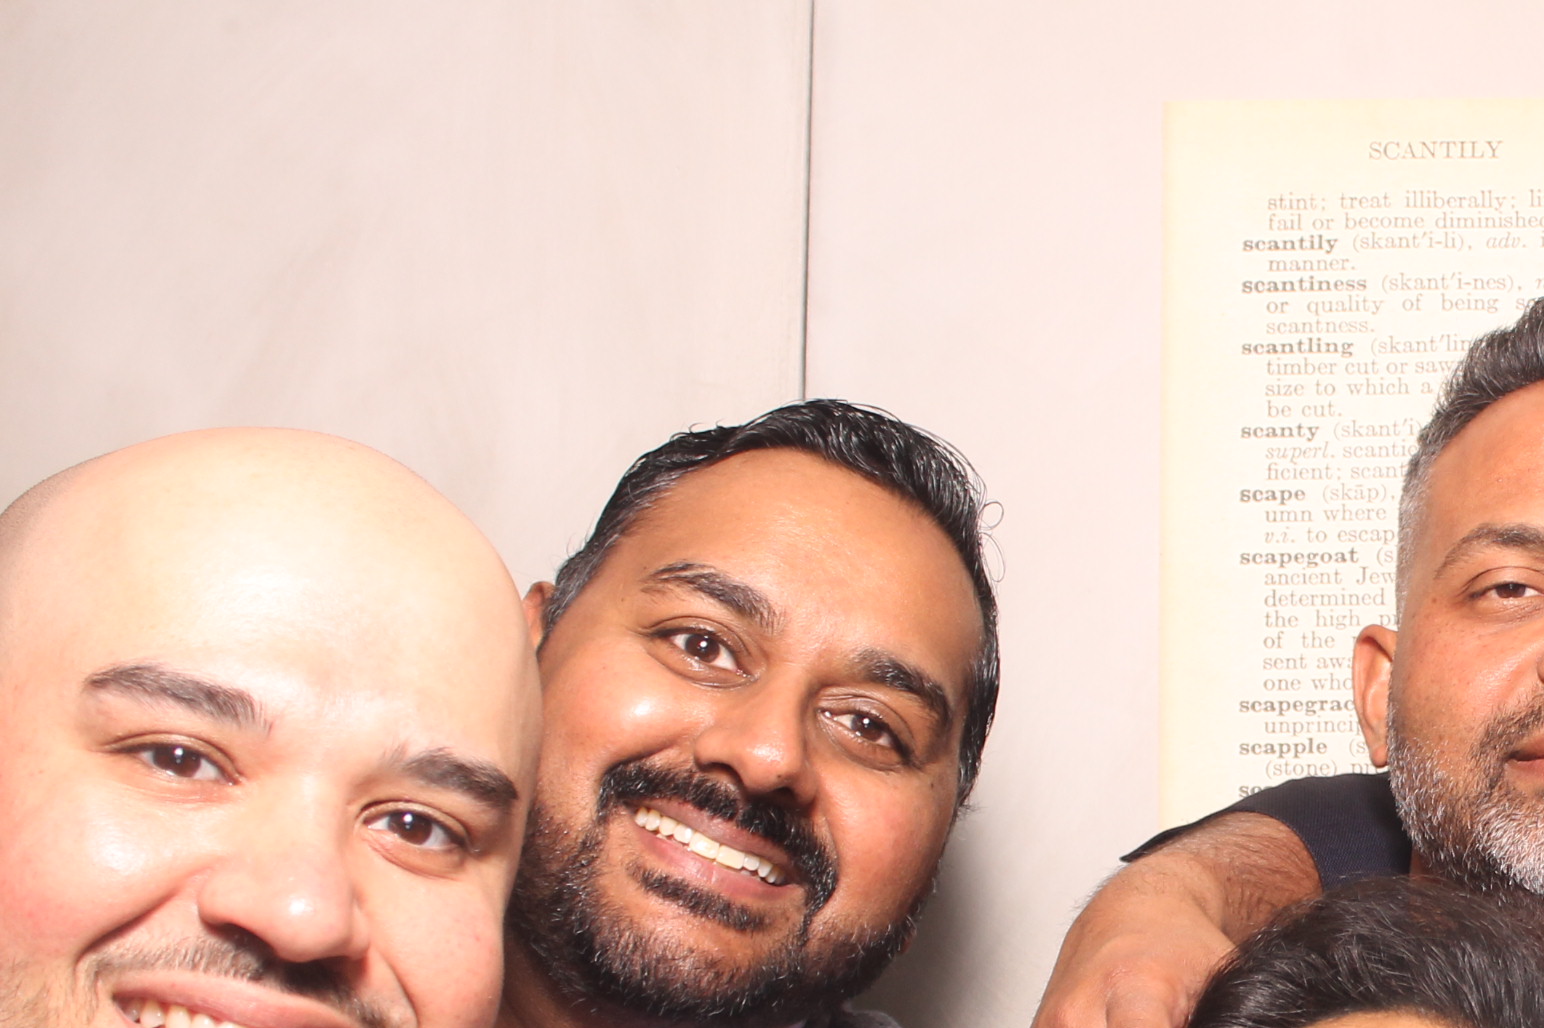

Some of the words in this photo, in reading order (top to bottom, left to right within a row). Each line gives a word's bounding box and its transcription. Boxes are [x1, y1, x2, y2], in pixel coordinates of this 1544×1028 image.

[1368, 140, 1503, 161] SCANTILY
[1267, 192, 1327, 211] stint;
[1340, 191, 1391, 209] treat
[1405, 189, 1516, 211] illiberally;
[1268, 213, 1302, 231] fail
[1312, 217, 1334, 231] or
[1345, 211, 1425, 230] become
[1242, 234, 1338, 253] scantily
[1486, 231, 1527, 249] adv.
[1267, 257, 1357, 273] manner.
[1241, 275, 1368, 294] scantiness
[1266, 300, 1289, 315] or
[1307, 294, 1384, 316] quality
[1402, 294, 1424, 312] of
[1441, 293, 1499, 313] being
[1266, 317, 1375, 335] scantness.
[1241, 337, 1354, 357] scantling
[1266, 357, 1337, 376] timber
[1344, 359, 1379, 375] cut
[1386, 363, 1409, 375] or
[1265, 378, 1304, 397] size
[1315, 380, 1336, 397] to
[1347, 376, 1410, 396] which
[1420, 381, 1433, 394] a
[1267, 400, 1292, 418] be
[1301, 401, 1343, 418] cut.
[1241, 424, 1320, 442] scanty
[1265, 441, 1335, 465] superl.
[1266, 462, 1342, 481] ficient;
[1239, 487, 1306, 506] scape
[1264, 508, 1313, 523] umn
[1323, 504, 1387, 522] where
[1264, 526, 1296, 544] v.i.
[1306, 527, 1328, 544] to
[1337, 528, 1398, 545] escap
[1239, 546, 1359, 568] scapegoat
[1264, 567, 1343, 586] ancient
[1264, 587, 1386, 607] determined
[1265, 610, 1299, 628] the
[1315, 609, 1361, 630] high
[1263, 631, 1284, 649] of
[1302, 630, 1336, 649] the
[1262, 653, 1308, 671] sent
[1262, 677, 1302, 691] one
[1239, 699, 1355, 716] scapegrac
[1239, 737, 1328, 758] scapple
[1265, 759, 1338, 779] (stone)
